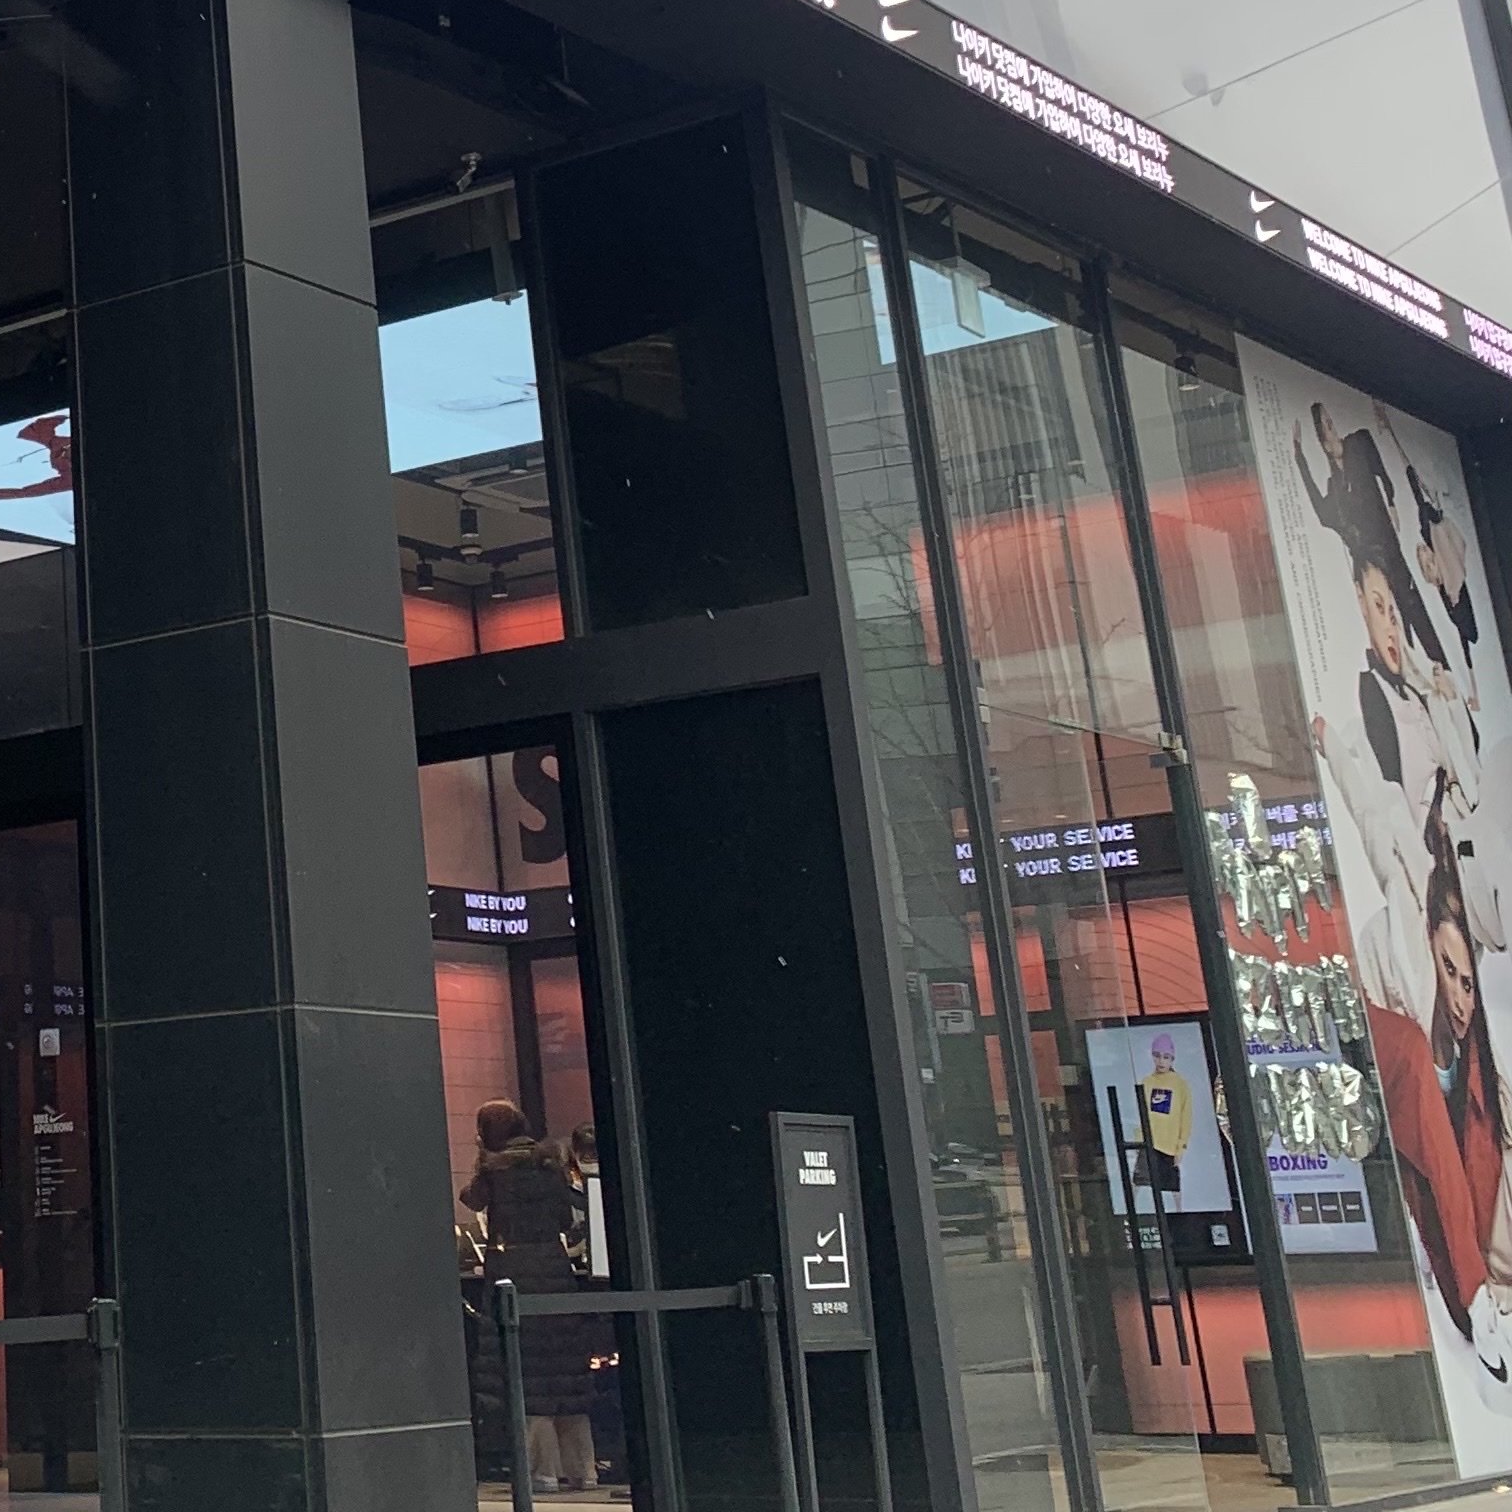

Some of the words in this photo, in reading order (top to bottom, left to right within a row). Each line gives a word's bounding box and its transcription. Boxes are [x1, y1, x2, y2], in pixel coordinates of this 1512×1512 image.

[952, 20, 992, 65] 나이키
[957, 54, 997, 99] 나이키
[1301, 218, 1352, 262] WELCOME
[1351, 246, 1366, 270] TO
[1307, 247, 1358, 292] WELCOME
[1357, 274, 1372, 298] TO
[1009, 833, 1059, 853] YOUR
[1014, 858, 1063, 878] YOUR
[1067, 849, 1139, 872] SEVICE
[501, 896, 526, 912] YOU
[503, 918, 529, 934] YOU
[803, 1151, 828, 1167] VALET
[799, 1169, 837, 1185] PARKING
